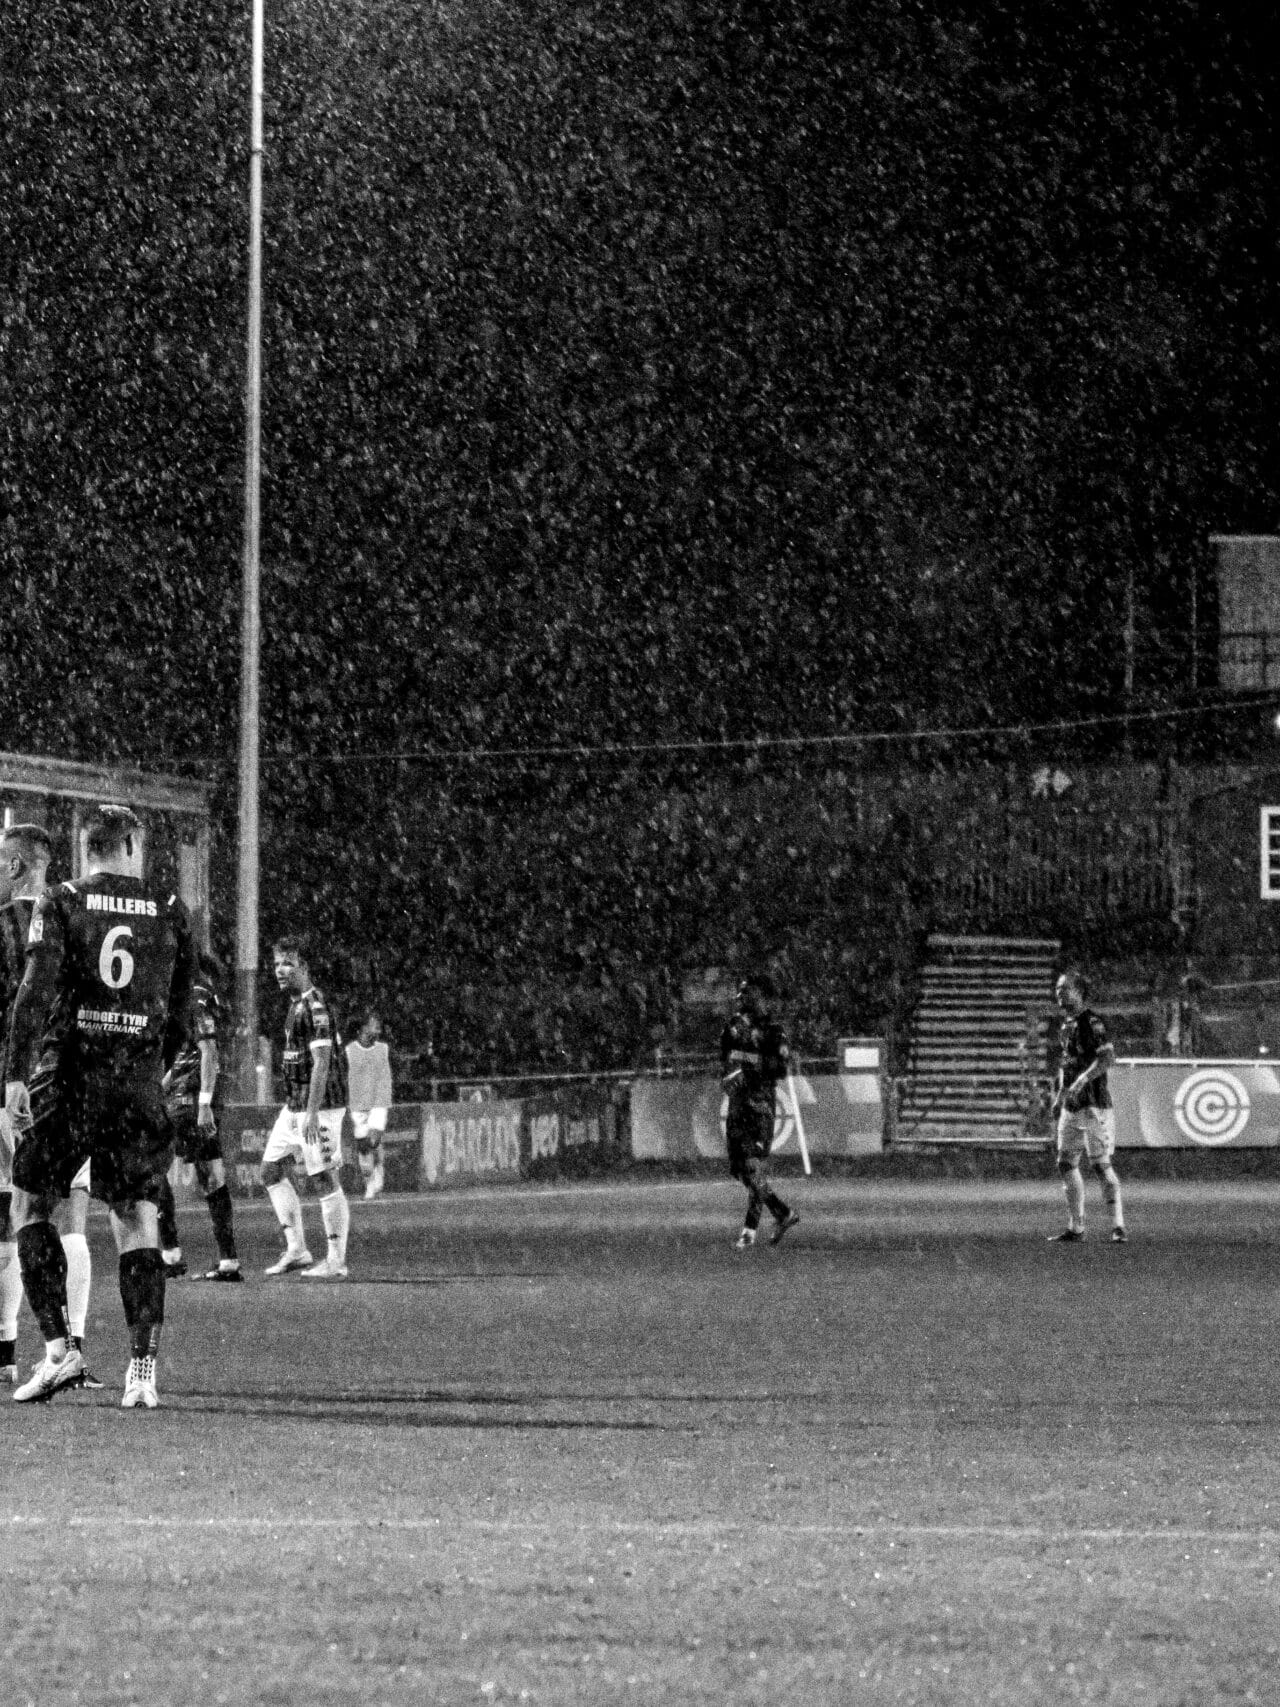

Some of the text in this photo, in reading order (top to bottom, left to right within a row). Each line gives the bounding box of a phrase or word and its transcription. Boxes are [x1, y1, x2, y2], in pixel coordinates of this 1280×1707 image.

[86, 894, 158, 917] MILLERS
[98, 925, 135, 989] 6
[77, 1009, 149, 1027] BUDGET TYRE
